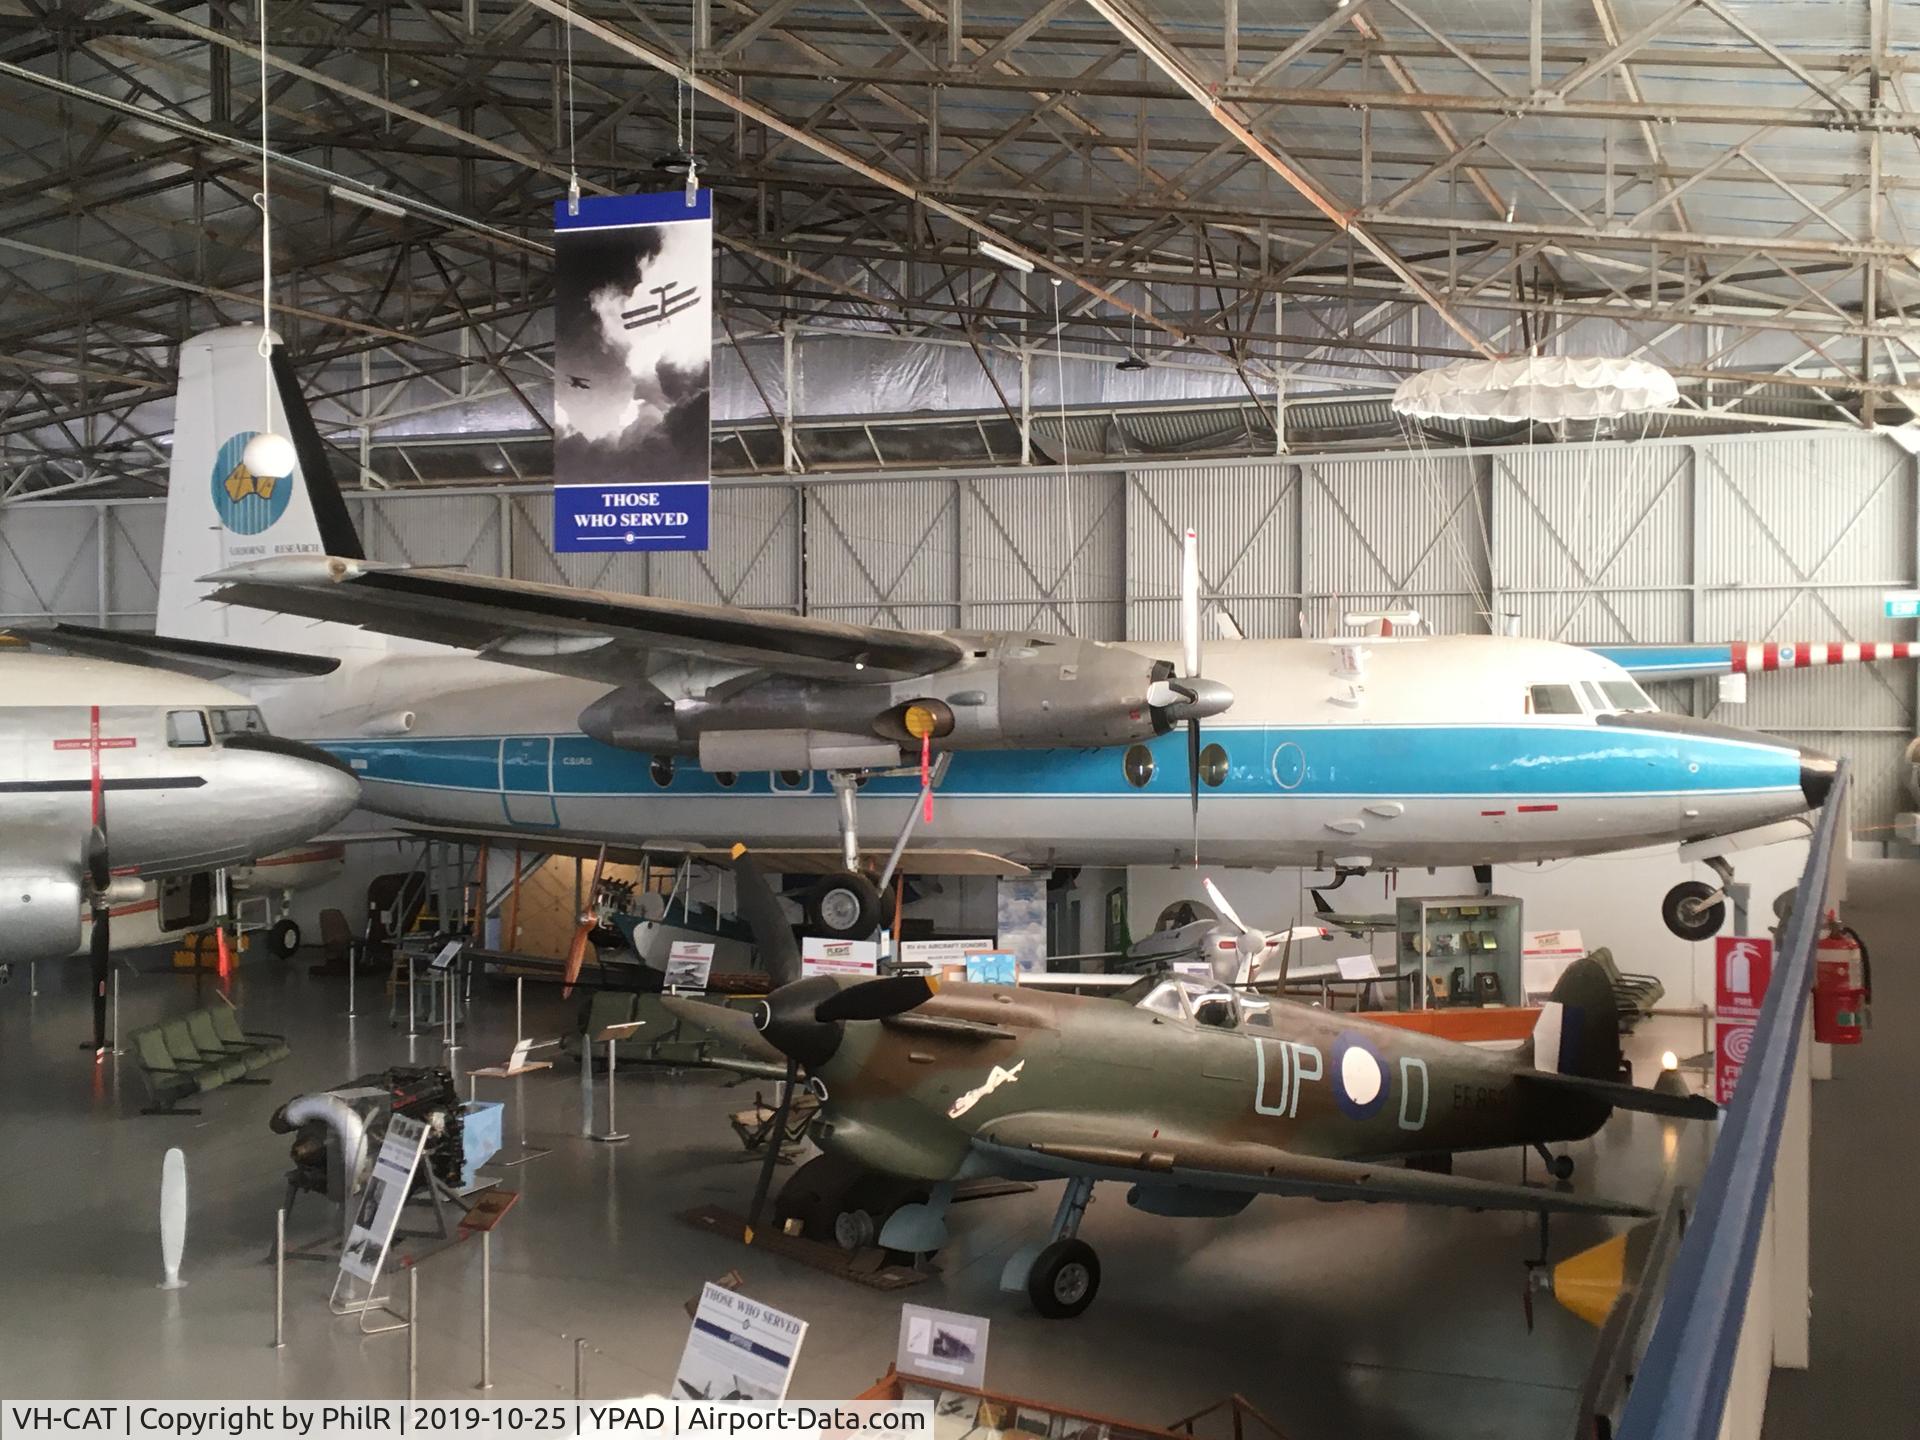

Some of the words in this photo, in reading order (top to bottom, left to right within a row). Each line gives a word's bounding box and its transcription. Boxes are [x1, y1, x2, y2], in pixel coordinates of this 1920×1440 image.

[601, 493, 660, 507] THOSE
[574, 514, 617, 527] WHO
[620, 512, 689, 526] SERVED
[1254, 1038, 1323, 1118] UP
[705, 1287, 735, 1308] THOSE
[737, 1300, 761, 1320] WHO
[763, 1310, 801, 1336] SERVED
